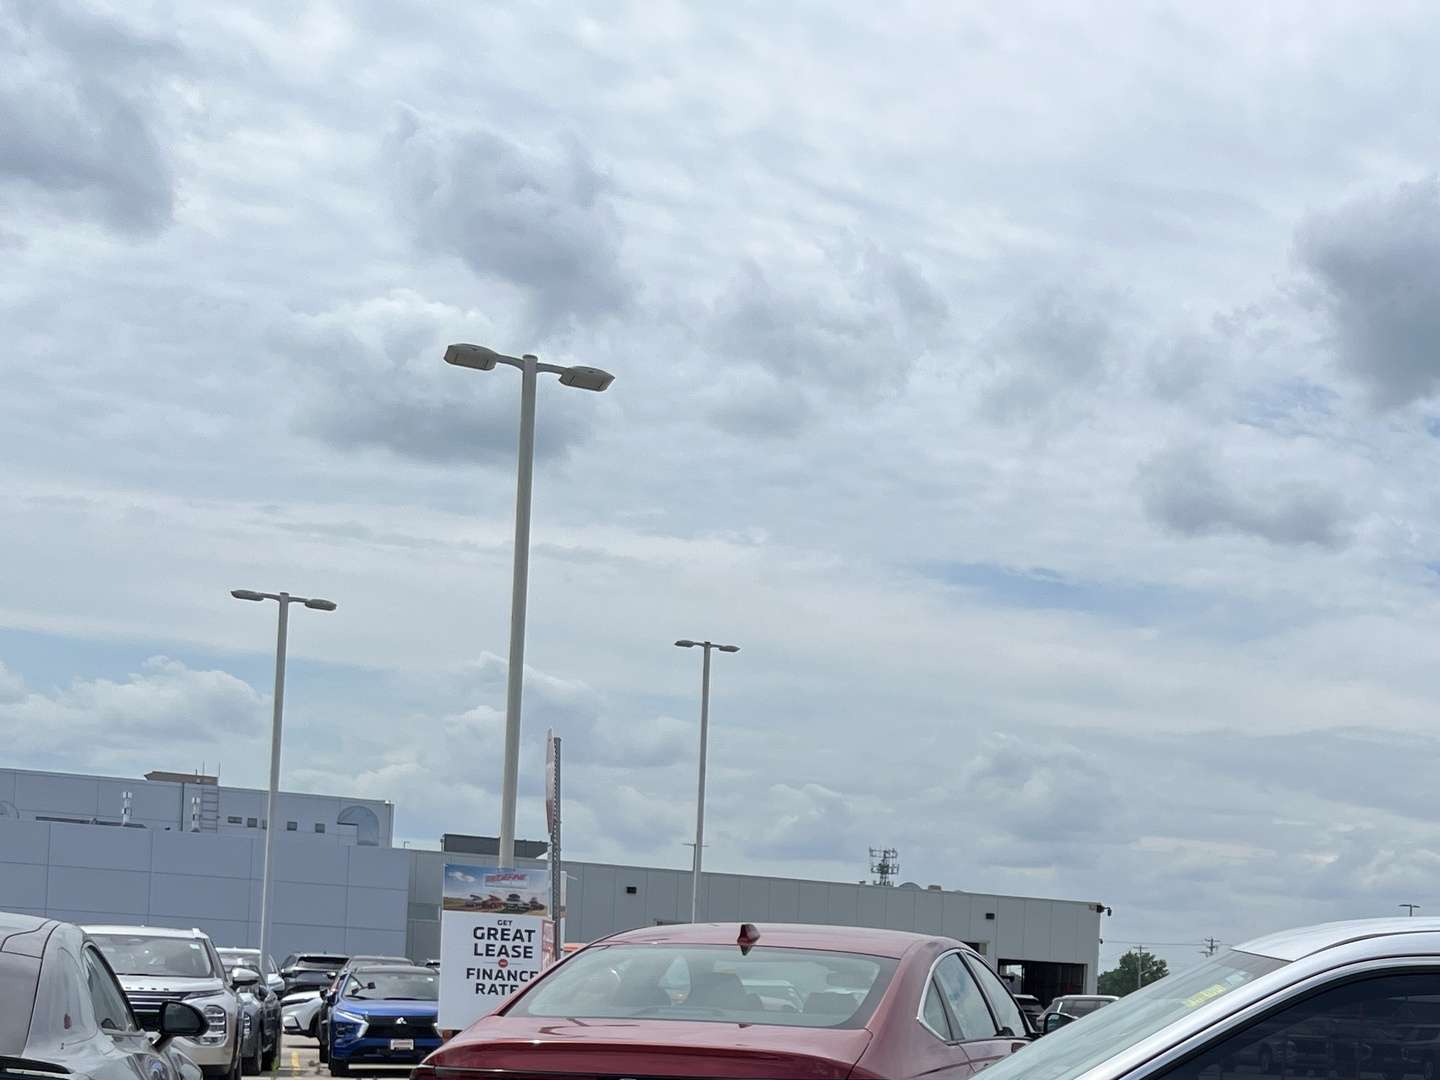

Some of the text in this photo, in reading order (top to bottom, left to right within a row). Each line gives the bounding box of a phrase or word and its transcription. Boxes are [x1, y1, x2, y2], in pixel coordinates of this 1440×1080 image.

[473, 926, 536, 943] GREAT
[474, 943, 534, 959] LEASE
[466, 967, 539, 982] FINANCE
